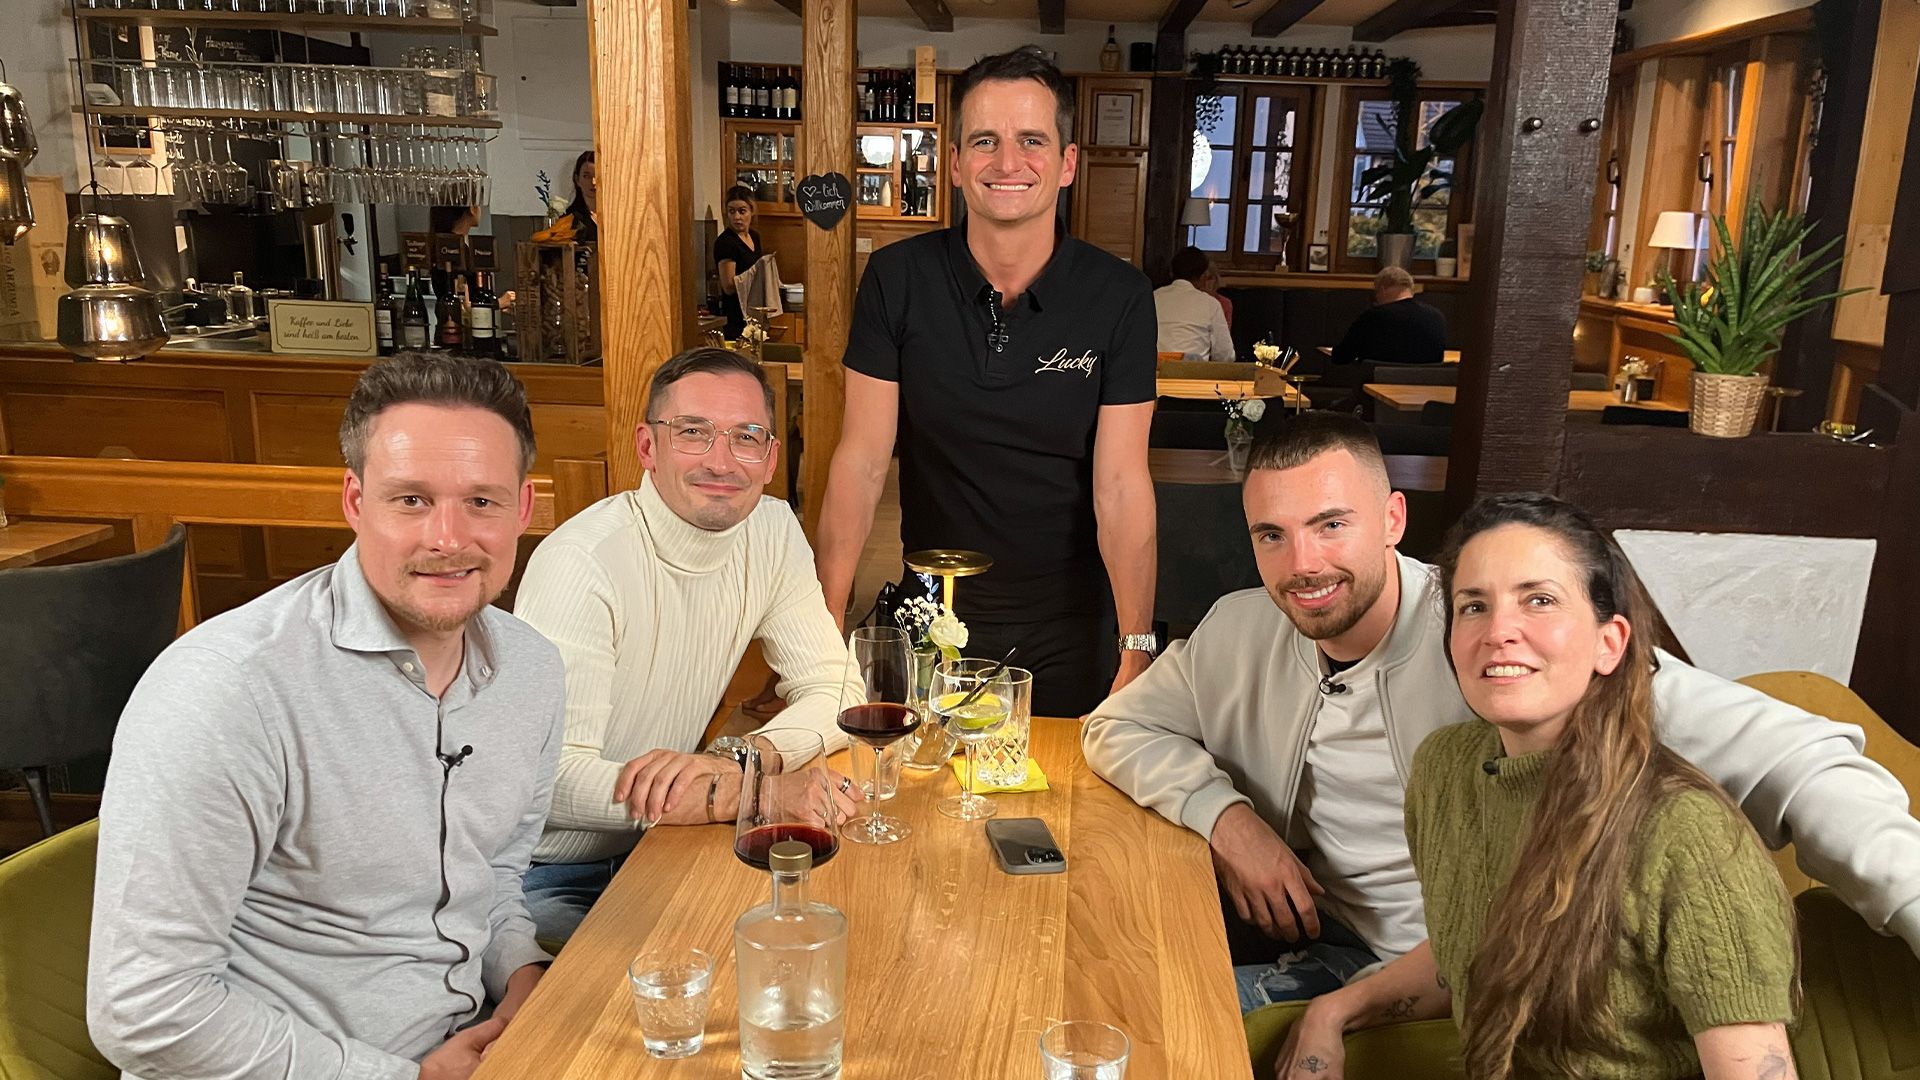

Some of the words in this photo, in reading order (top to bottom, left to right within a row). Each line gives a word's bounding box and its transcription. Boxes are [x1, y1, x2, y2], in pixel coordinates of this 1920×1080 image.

[805, 199, 846, 213] Willkommen
[289, 316, 314, 327] Kaffee
[316, 319, 331, 327] und
[334, 318, 353, 327] Liebe
[283, 329, 300, 338] sind
[302, 329, 319, 339] heiß
[1034, 347, 1098, 378] Lucky
